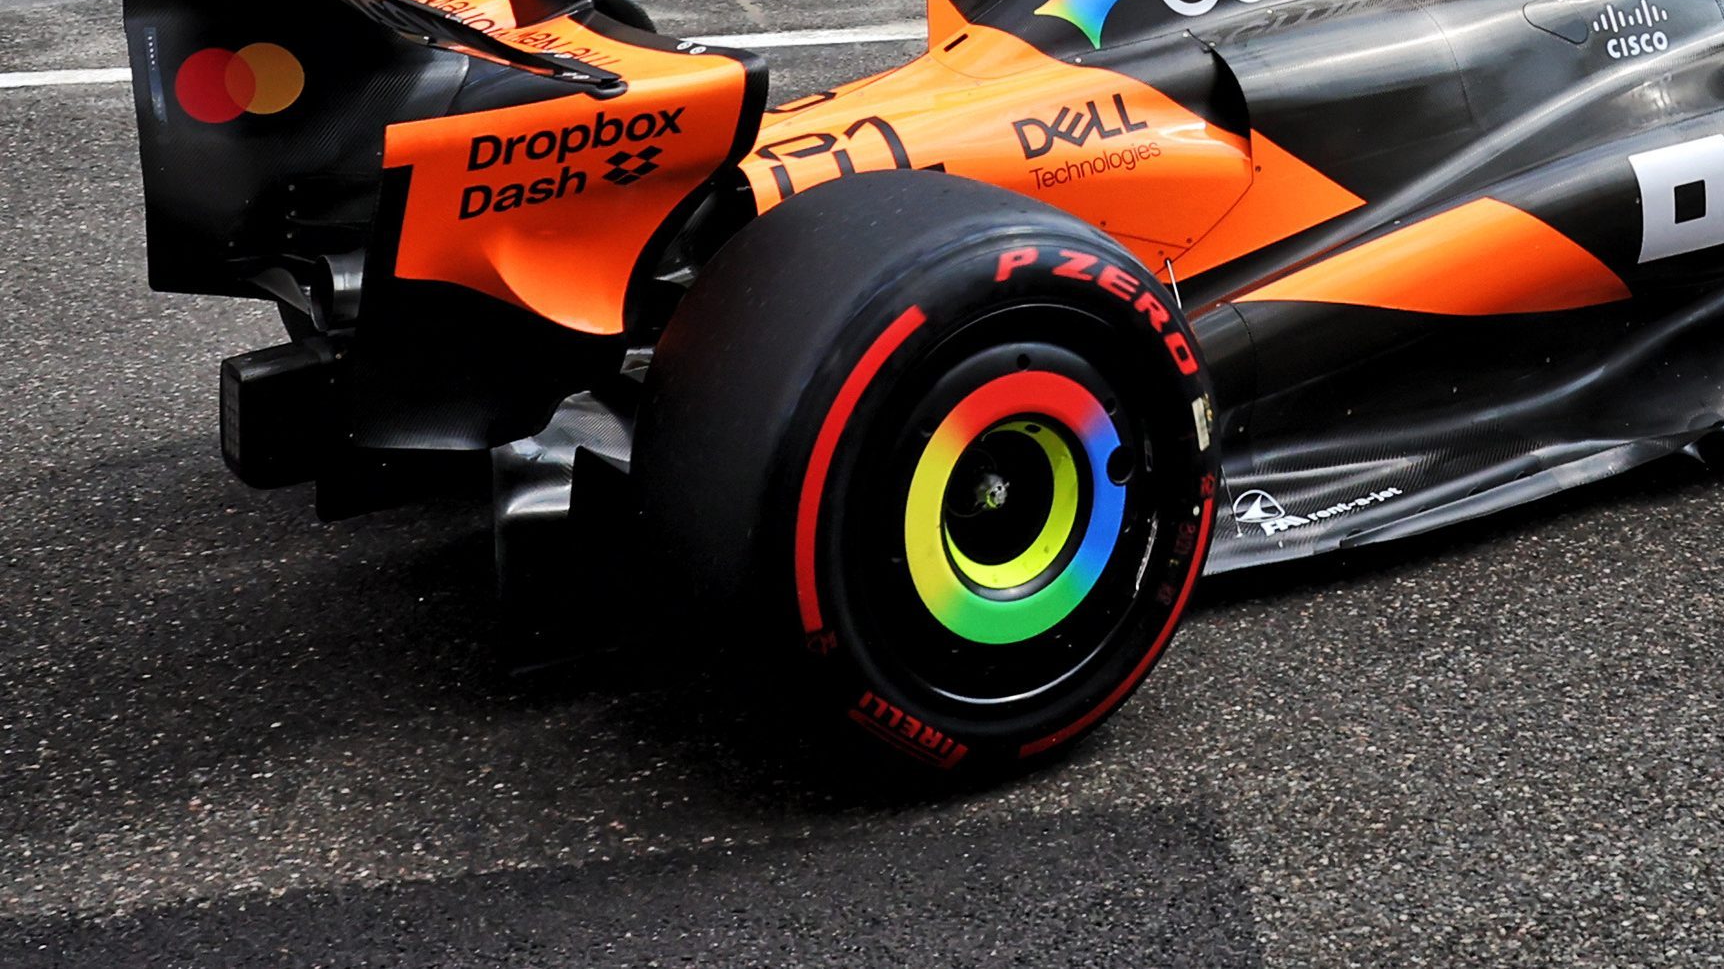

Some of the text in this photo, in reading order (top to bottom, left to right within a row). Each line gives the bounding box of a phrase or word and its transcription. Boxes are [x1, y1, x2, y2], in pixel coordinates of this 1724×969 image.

[466, 106, 686, 171] Dropbox
[1011, 93, 1148, 160] DELL
[458, 166, 586, 220] Dash
[1030, 141, 1162, 191] Technologies
[994, 247, 1199, 376] P ZERO
